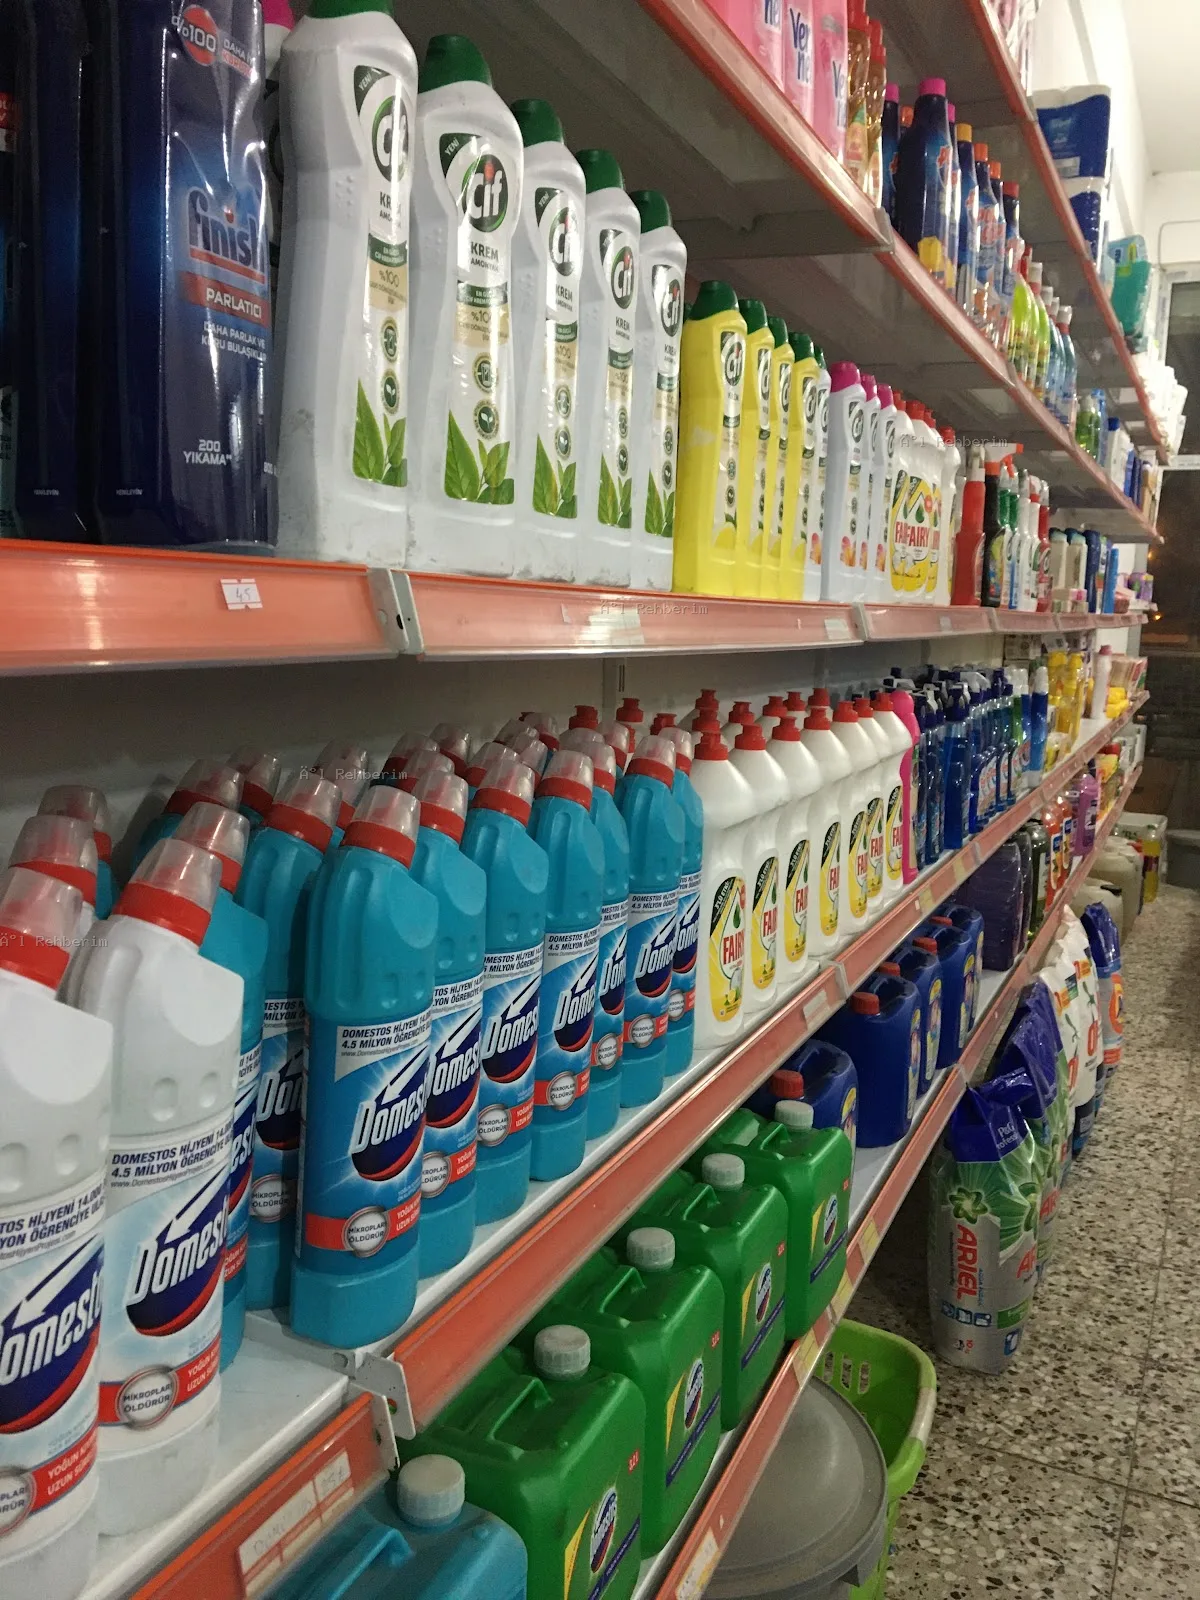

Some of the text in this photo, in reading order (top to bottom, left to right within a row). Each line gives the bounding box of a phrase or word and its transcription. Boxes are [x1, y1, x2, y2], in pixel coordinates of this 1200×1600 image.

[201, 335, 226, 350] KRU
[199, 440, 220, 452] 200
[342, 1025, 391, 1038] DOMESTOS
[342, 1040, 357, 1049] 4.5
[360, 1035, 392, 1048] MİLYON
[112, 1147, 178, 1165] DOMESTOS
[111, 1167, 131, 1178] 4.5
[134, 1160, 178, 1177] MİLYON
[956, 1224, 978, 1299] ARIEL
[123, 1393, 170, 1413] ÖLDÜRÜR
